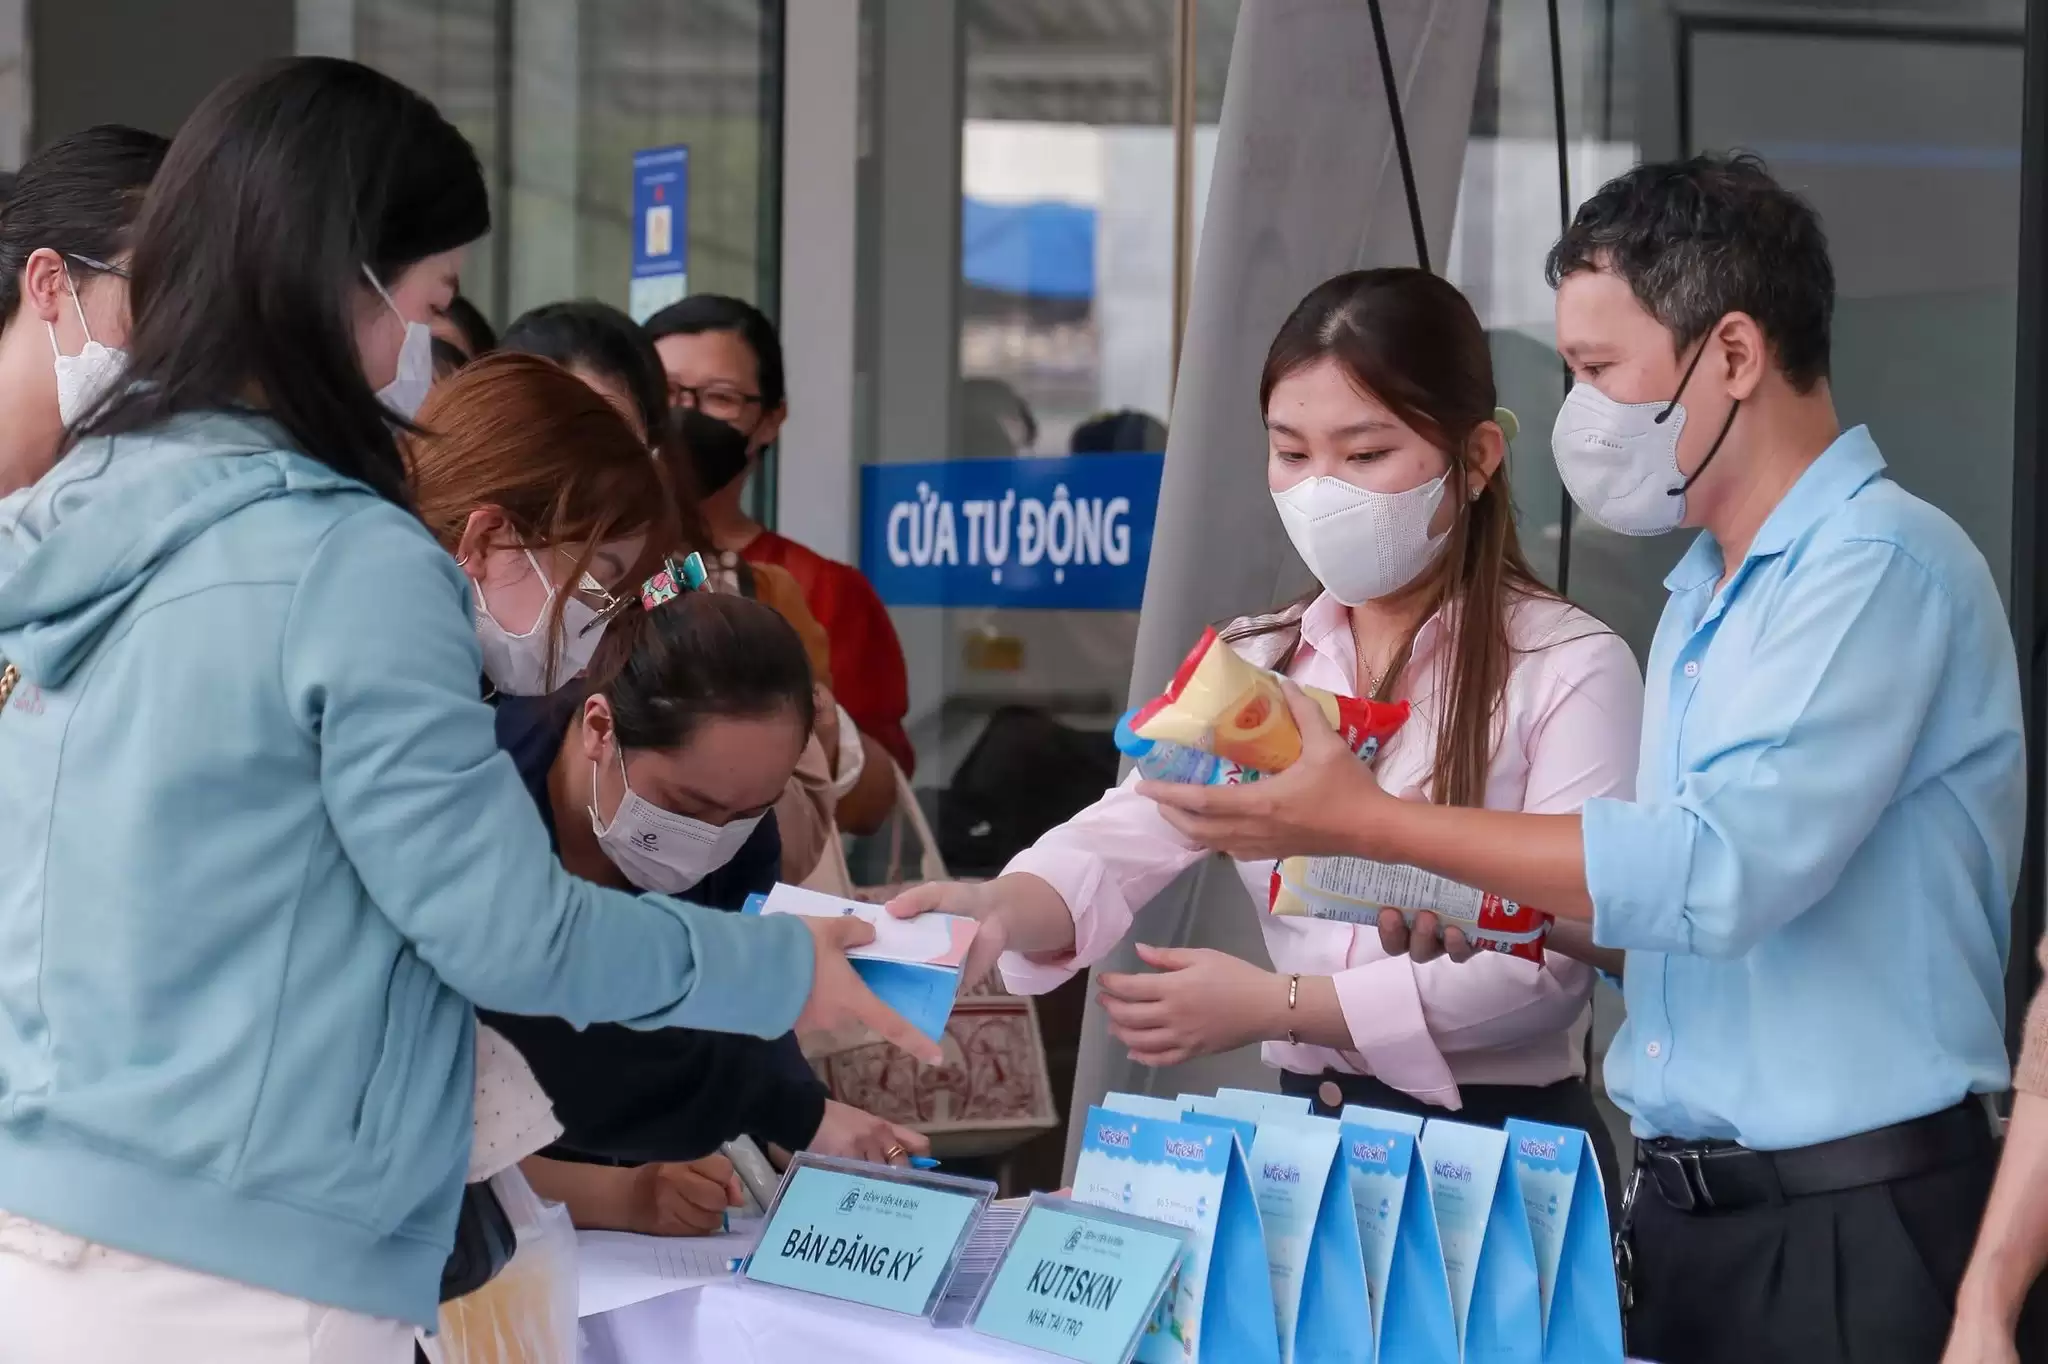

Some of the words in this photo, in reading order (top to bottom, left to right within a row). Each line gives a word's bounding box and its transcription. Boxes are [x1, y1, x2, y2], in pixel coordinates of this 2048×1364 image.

[887, 481, 959, 567] CỬA
[962, 488, 1015, 585] TỰ
[1017, 483, 1130, 585] ĐỘNG
[781, 1225, 830, 1264] BÀN
[826, 1234, 890, 1276] ĐĂNG
[887, 1247, 924, 1283] KÝ
[1026, 1258, 1123, 1312] KUTISKIN
[1026, 1307, 1048, 1328] NHÀ
